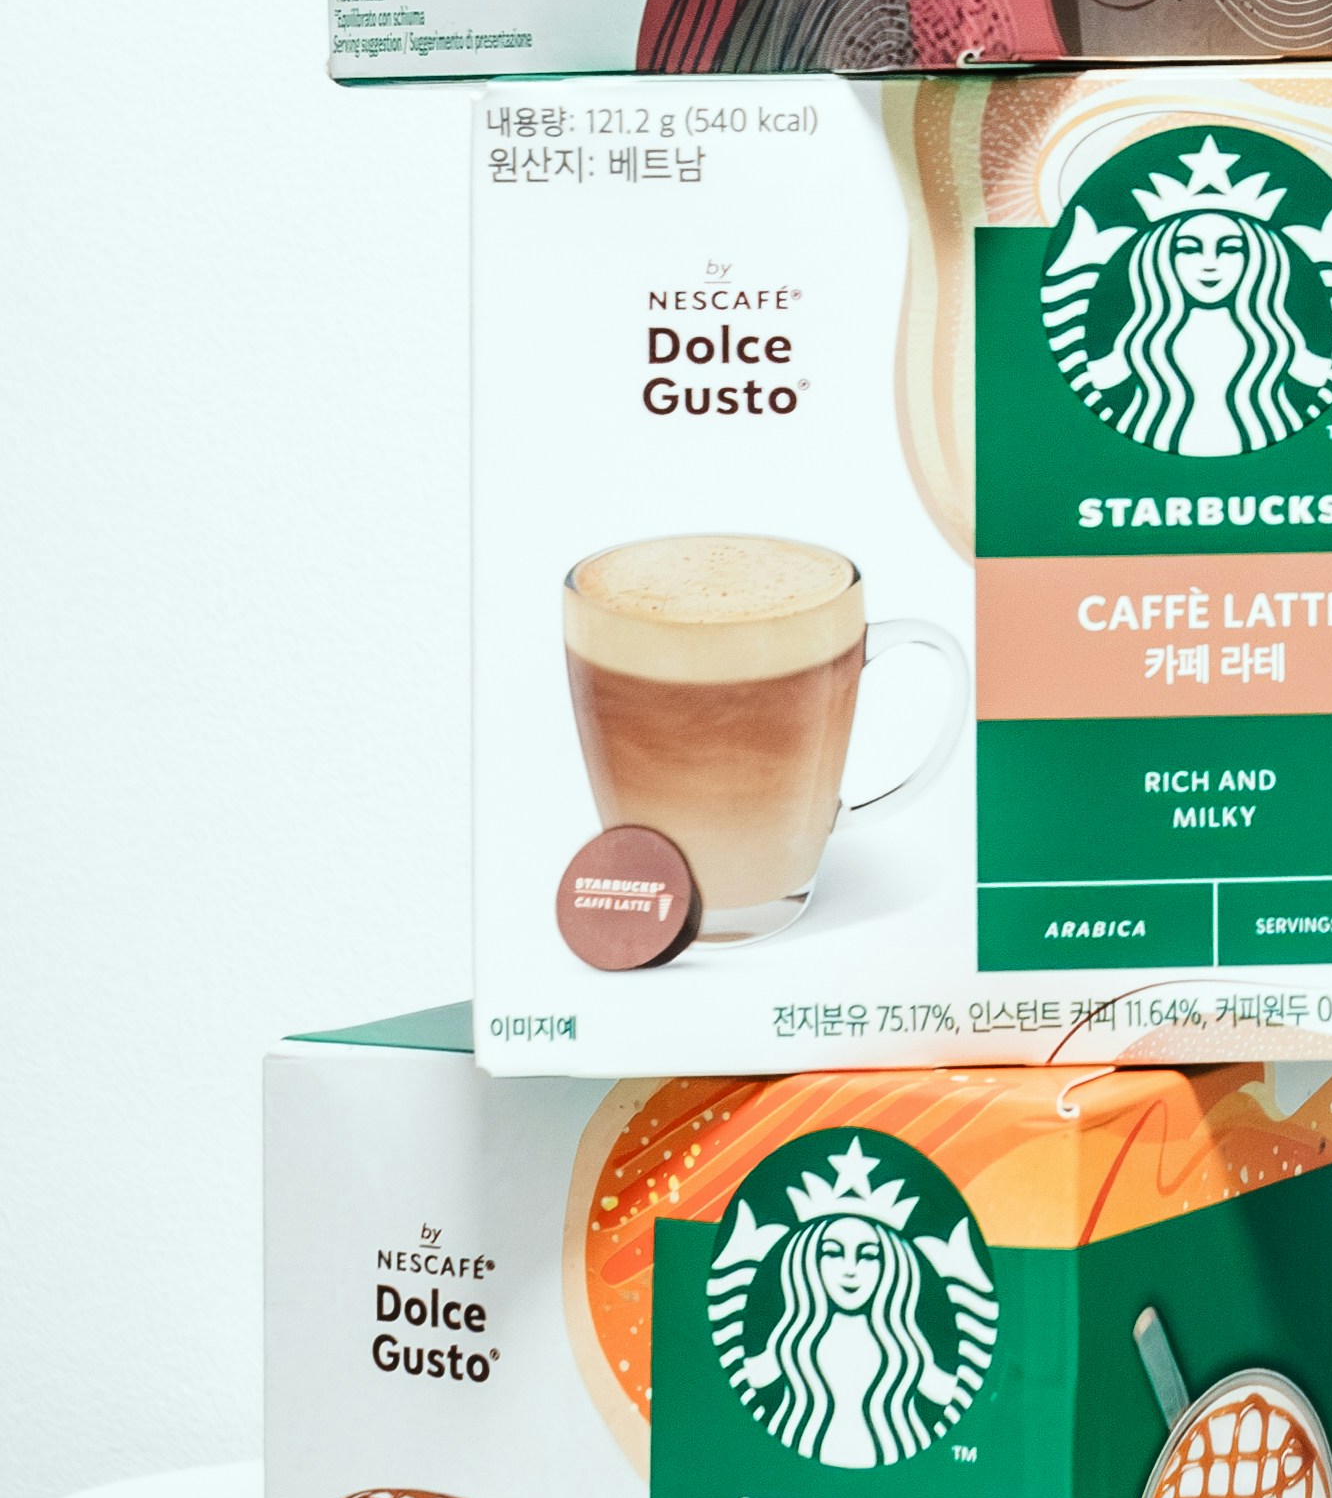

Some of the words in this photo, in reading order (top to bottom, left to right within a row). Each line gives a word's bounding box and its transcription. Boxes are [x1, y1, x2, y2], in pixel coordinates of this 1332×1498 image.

[486, 107, 576, 137] 내용량:
[587, 109, 649, 134] 121.2
[660, 115, 675, 137] g
[684, 107, 746, 136] (540
[759, 106, 817, 135] kcal)
[488, 147, 593, 183] 원산지:
[609, 146, 705, 182] 베트남
[706, 260, 732, 279] by
[649, 325, 791, 364] Dolce
[1078, 587, 1209, 631] CAFFÈ
[1145, 644, 1209, 684] 카페
[1221, 642, 1285, 683] 라테
[1145, 771, 1209, 792] RICH
[1219, 770, 1276, 790] AND
[1174, 806, 1255, 827] MILKY
[1045, 920, 1145, 937] ARABICA
[491, 1016, 576, 1041] 이미지예
[774, 1004, 868, 1037] 전지분유
[877, 1004, 959, 1034] 75.17%,
[969, 1000, 1062, 1033] 인스턴트
[1071, 997, 1119, 1032] 커피
[1122, 994, 1207, 1029] 11.64%,
[1216, 994, 1309, 1027] 커피원두
[421, 1223, 441, 1244] by
[376, 1284, 487, 1333] Dolce
